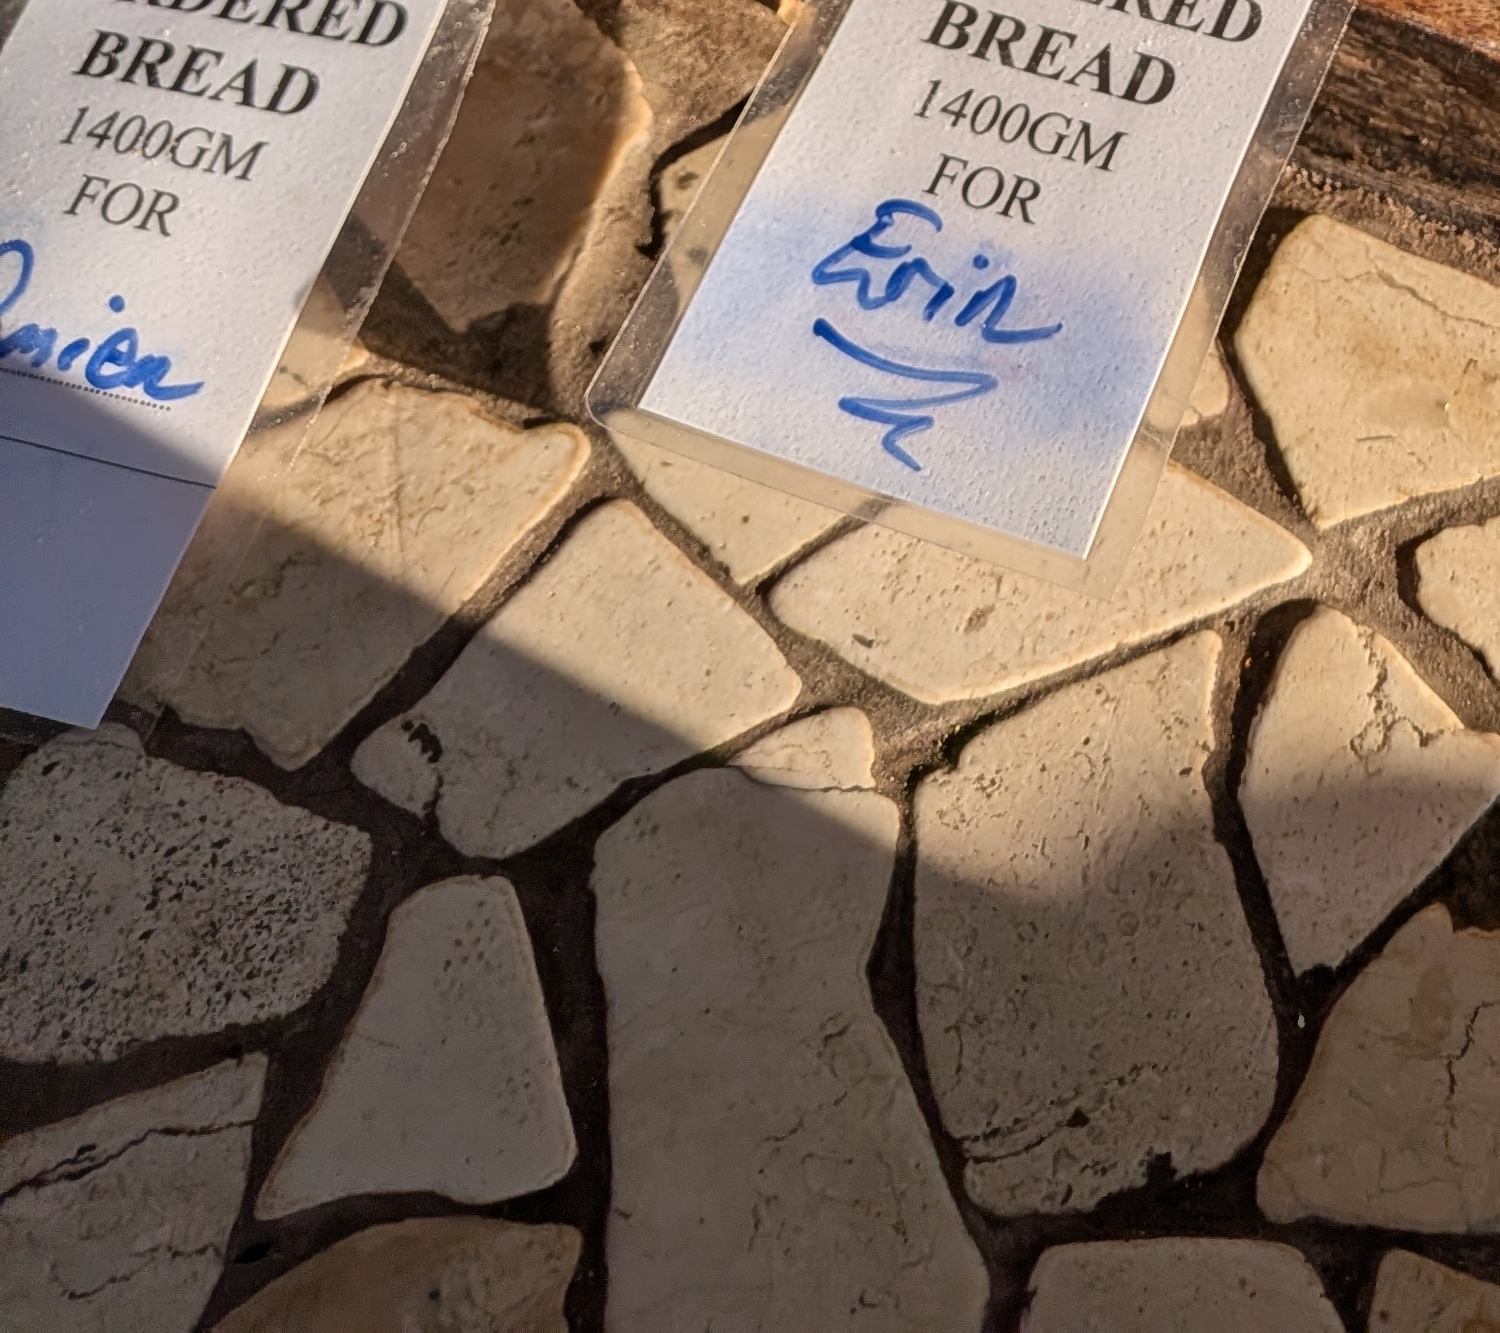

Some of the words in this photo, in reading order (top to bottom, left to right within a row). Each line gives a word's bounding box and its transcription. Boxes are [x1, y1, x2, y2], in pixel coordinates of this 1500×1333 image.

[72, 29, 320, 115] BREAD
[61, 106, 270, 181] 1400GM
[914, 79, 1128, 171] 1400GM
[64, 174, 180, 237] FOR
[922, 154, 1043, 224] FOR
[812, 199, 1063, 343] Erin
